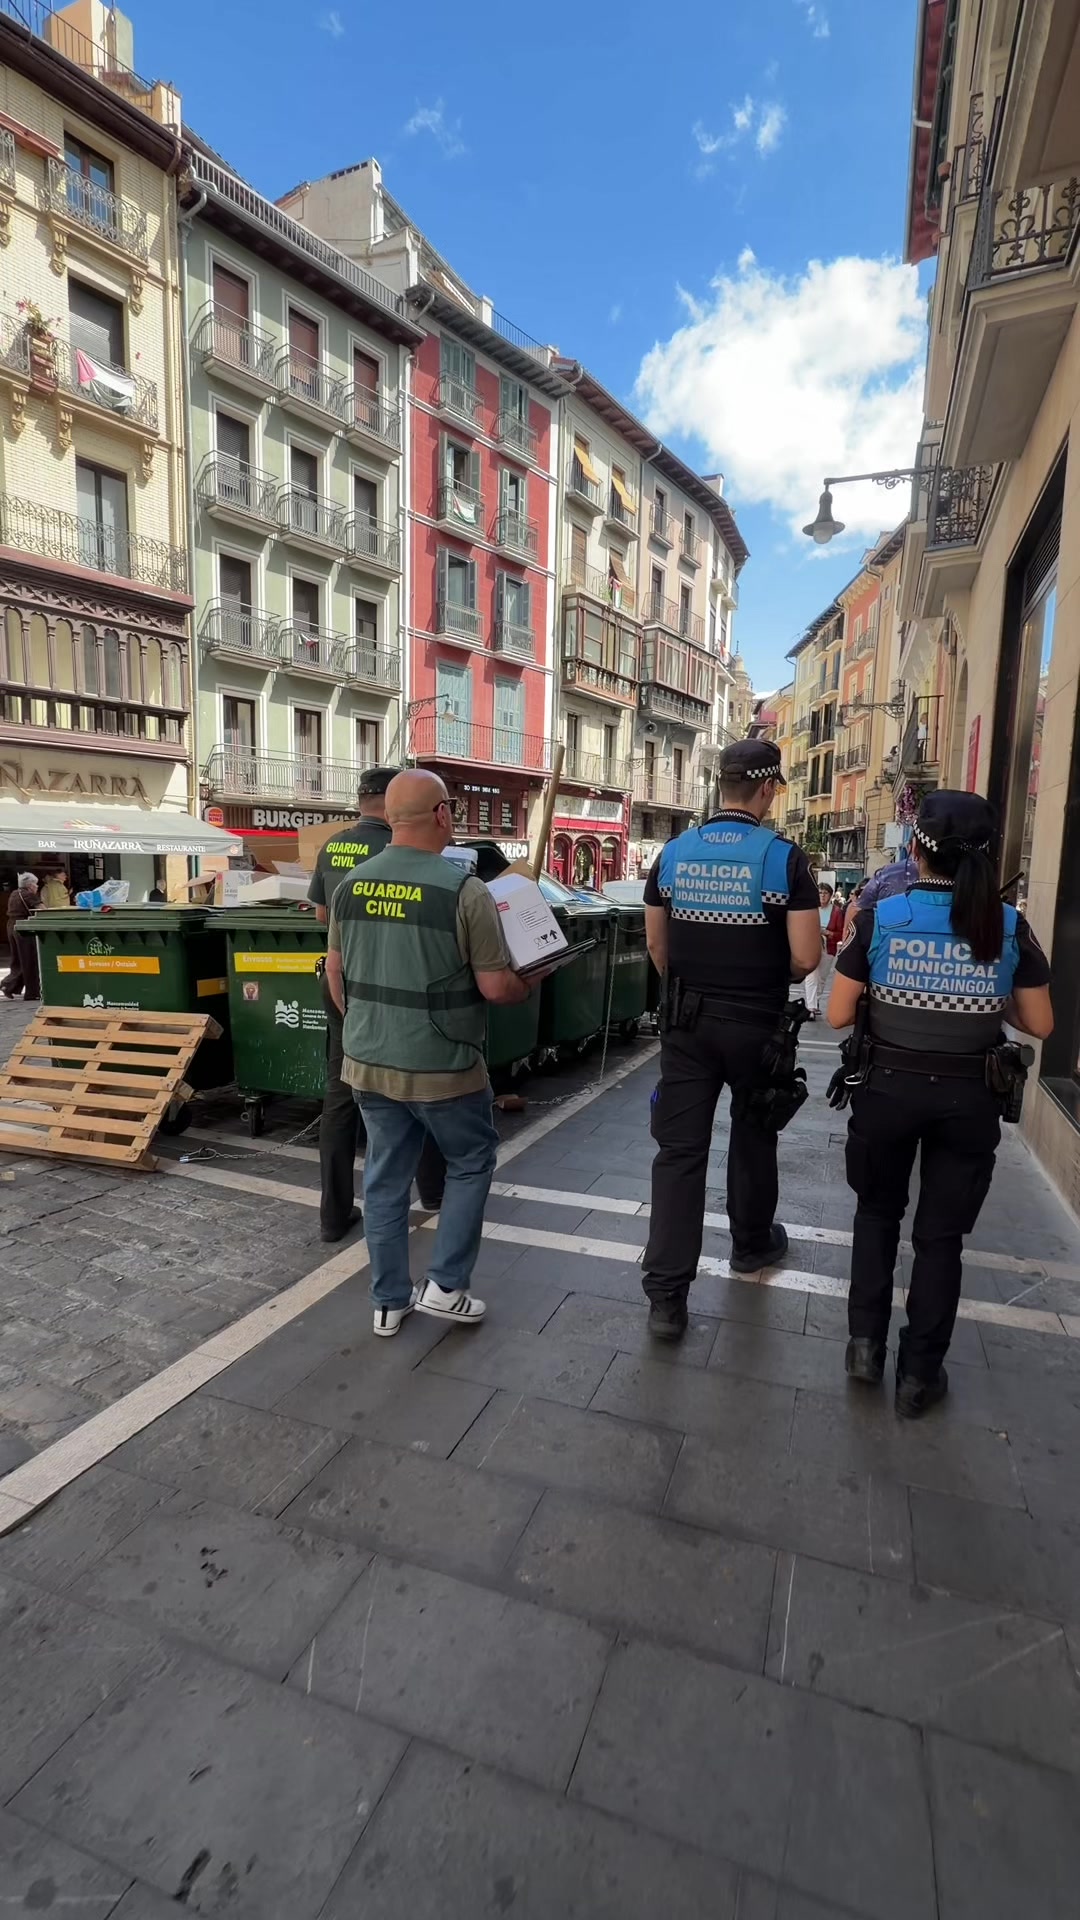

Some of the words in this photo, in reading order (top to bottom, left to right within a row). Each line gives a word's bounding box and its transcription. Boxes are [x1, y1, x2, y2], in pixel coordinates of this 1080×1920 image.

[253, 809, 325, 828] BURGER
[38, 840, 57, 849] BAR
[73, 838, 145, 852] IRUÑAZARRA
[156, 844, 206, 853] RESTAURANTE
[702, 831, 742, 843] POLICIA
[326, 842, 369, 855] GUARDIA
[331, 855, 356, 868] CIVIL
[675, 862, 752, 880] POLICIA
[352, 881, 423, 901] GUARDIA
[674, 877, 751, 893] MUNICIPAL
[675, 890, 751, 906] UDALTZAINGOA
[365, 900, 406, 918] CIVIL
[888, 957, 998, 979] MUNICIPAL
[886, 971, 995, 994] UDALTZAINGOA
